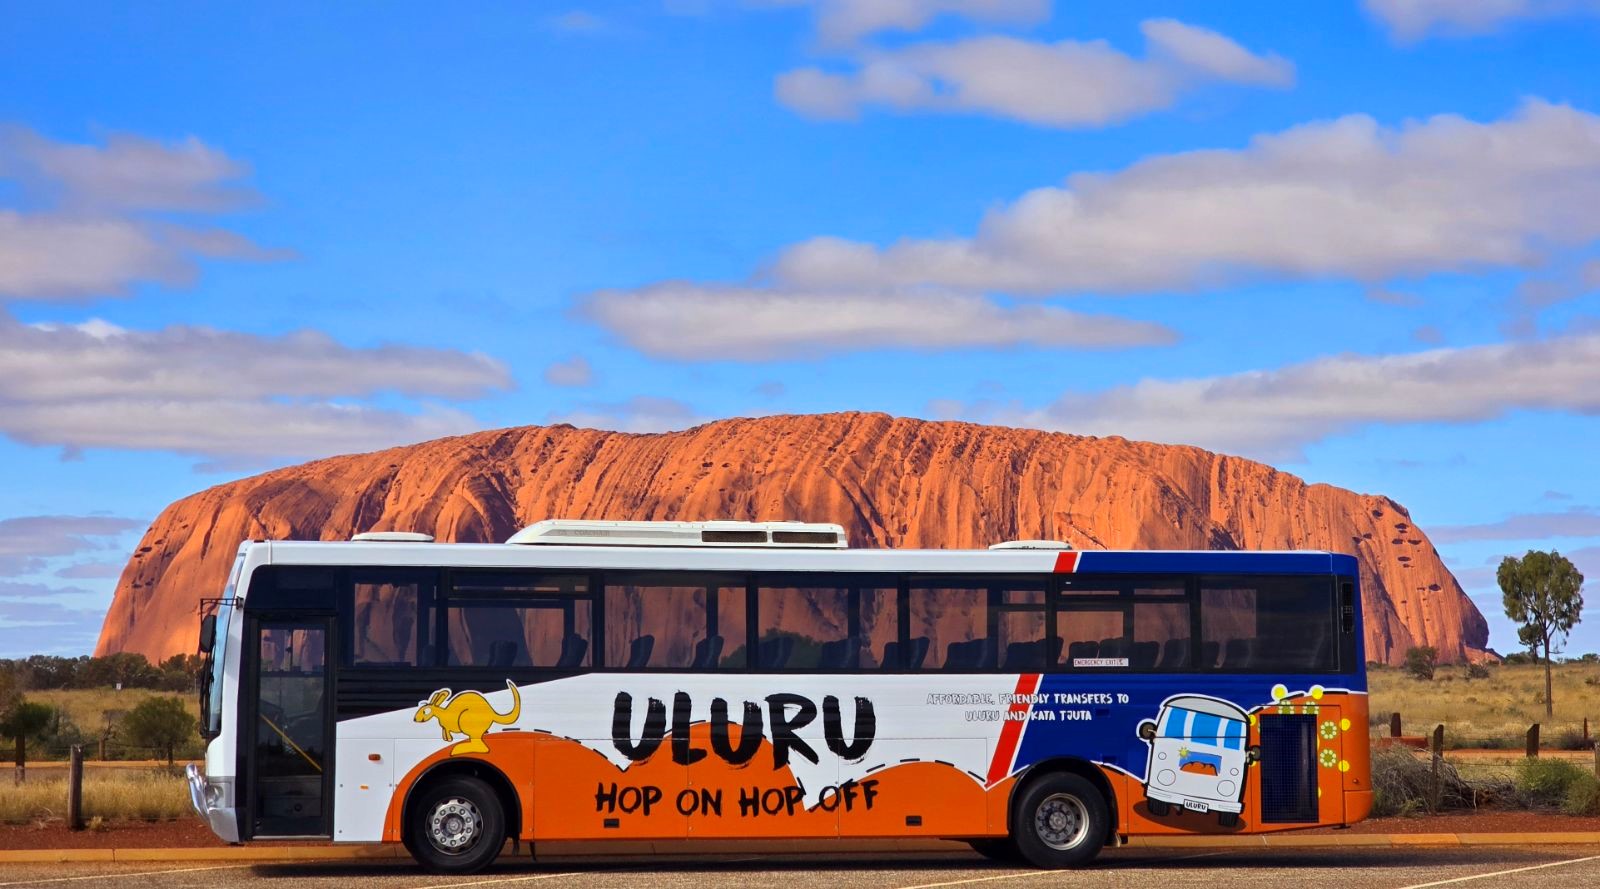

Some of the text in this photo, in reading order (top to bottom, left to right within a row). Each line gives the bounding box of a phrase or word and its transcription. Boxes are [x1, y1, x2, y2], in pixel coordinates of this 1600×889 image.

[926, 693, 1129, 706] AFFORDABLE, FRIENDLY TRANSFERS TO
[965, 710, 1092, 722] ULURU AND KATA TJUTA
[611, 690, 876, 770] ULURU
[595, 779, 879, 817] HOP ON HOP OFF
[1185, 802, 1206, 810] ULURU
